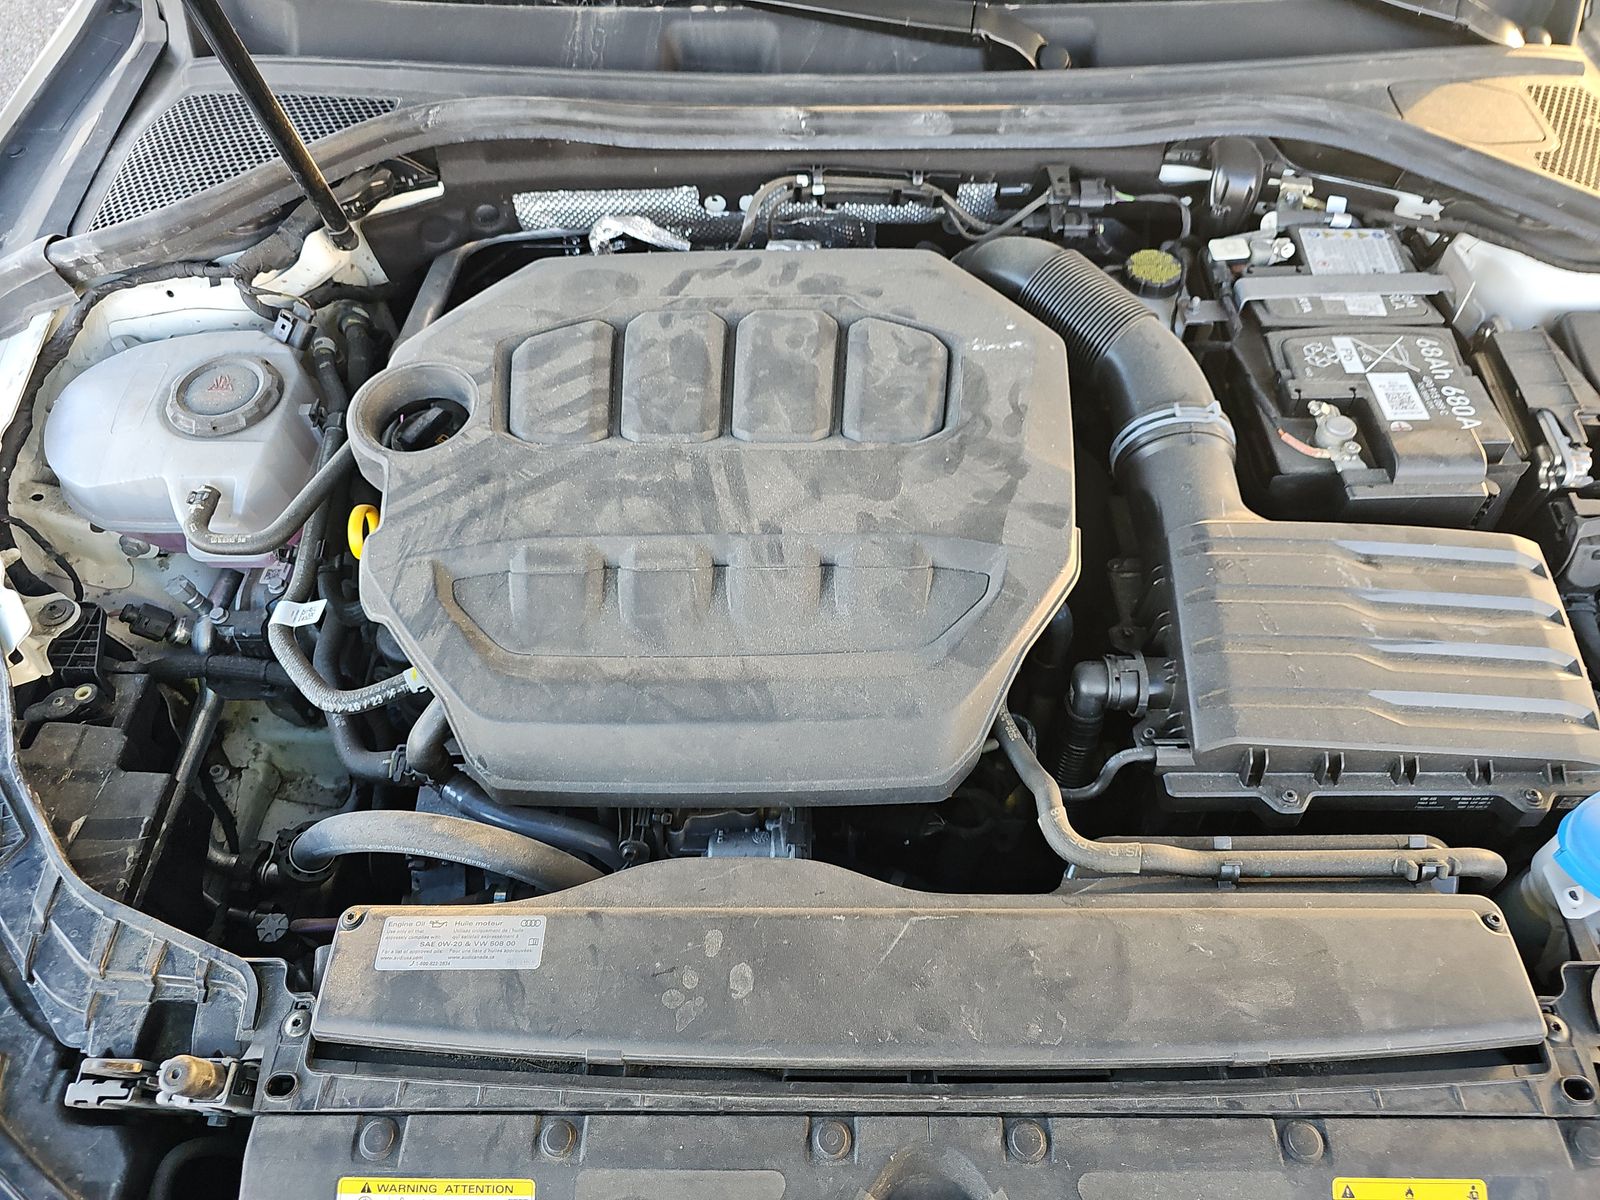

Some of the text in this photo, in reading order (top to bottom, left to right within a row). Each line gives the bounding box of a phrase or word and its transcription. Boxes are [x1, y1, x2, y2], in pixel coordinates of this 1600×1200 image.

[1416, 337, 1454, 380] 68Ah
[1441, 385, 1482, 430] 680A
[388, 920, 413, 928] Engine
[376, 1184, 514, 1194] WARNING ATTENTION
